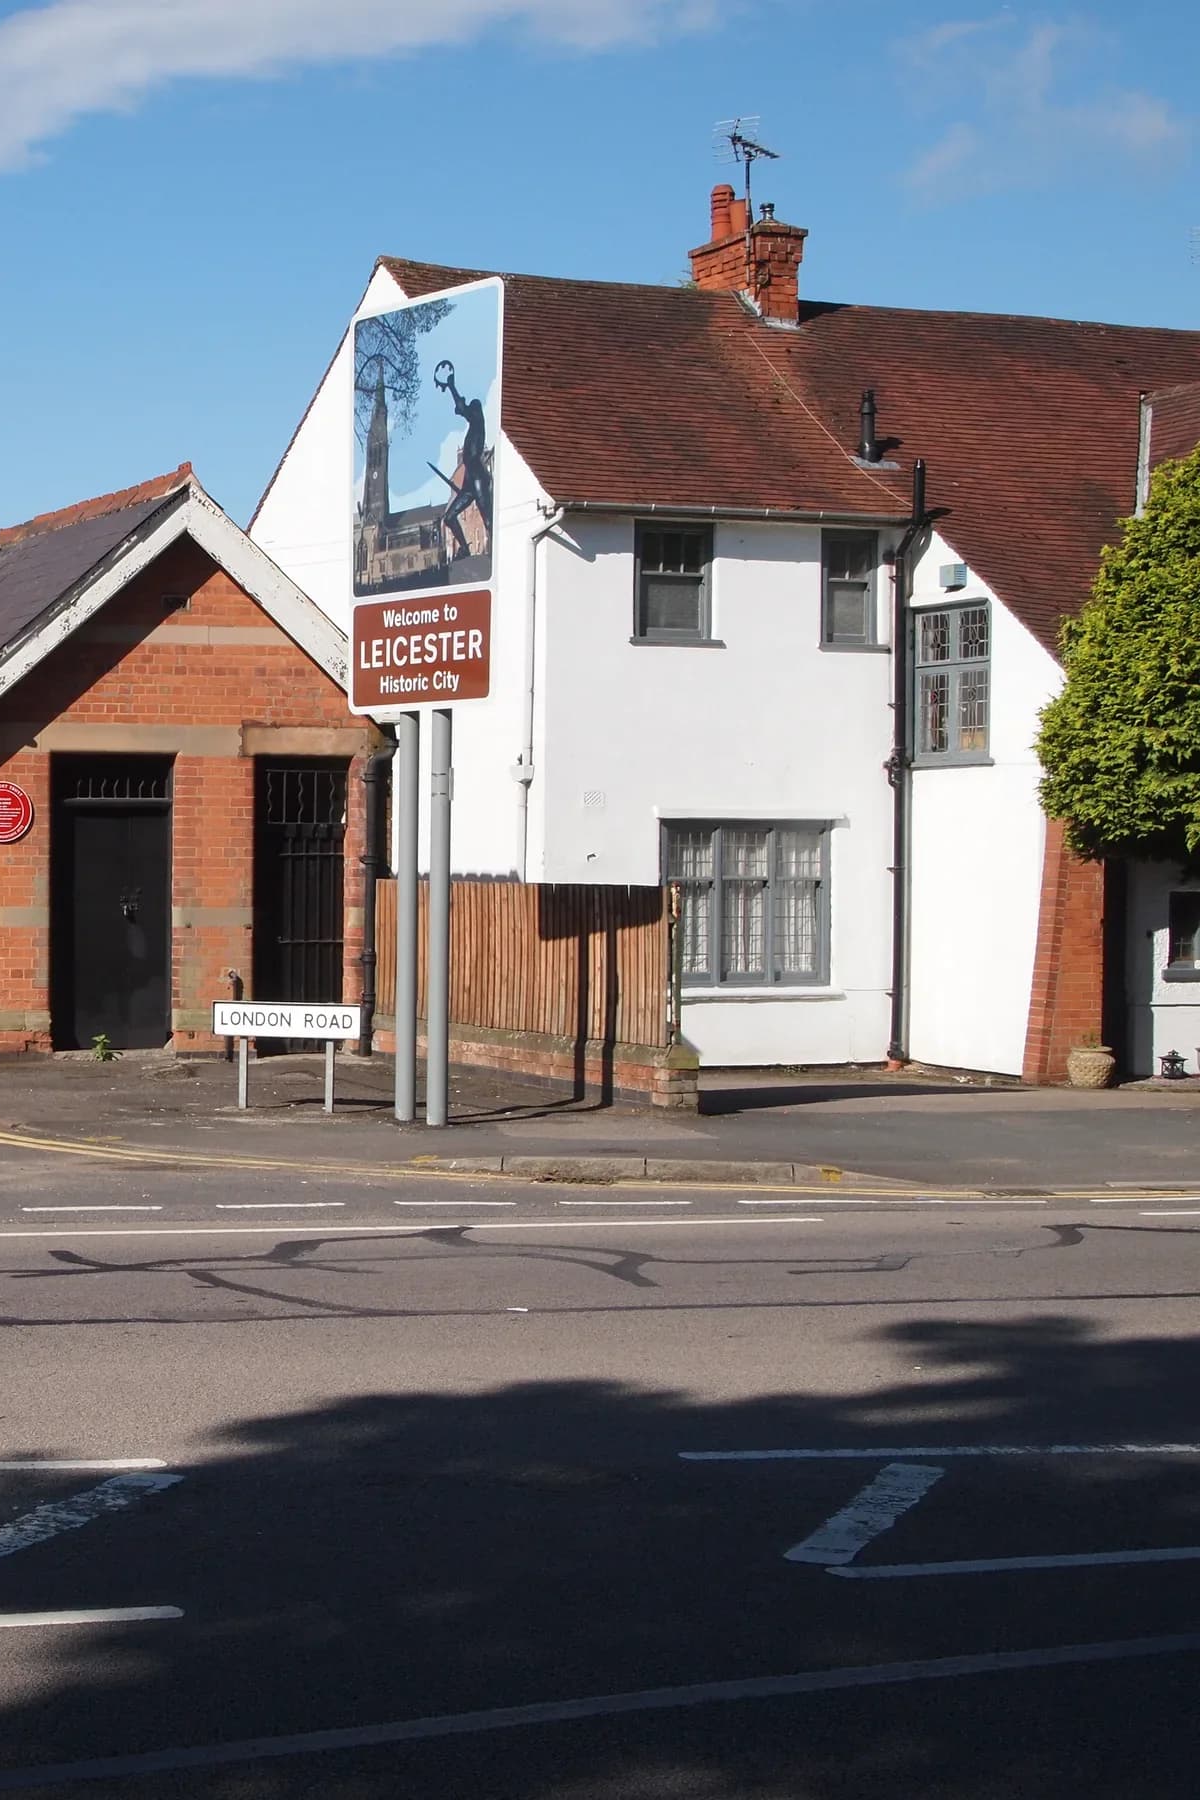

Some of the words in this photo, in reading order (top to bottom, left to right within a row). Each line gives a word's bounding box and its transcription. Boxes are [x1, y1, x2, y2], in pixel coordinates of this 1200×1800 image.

[383, 607, 440, 628] Welcome
[443, 603, 458, 622] to
[360, 629, 483, 669] LEICESTER
[379, 673, 429, 694] Historic
[432, 670, 460, 692] City
[220, 1010, 292, 1028] LONDON
[303, 1013, 353, 1029] ROAD
